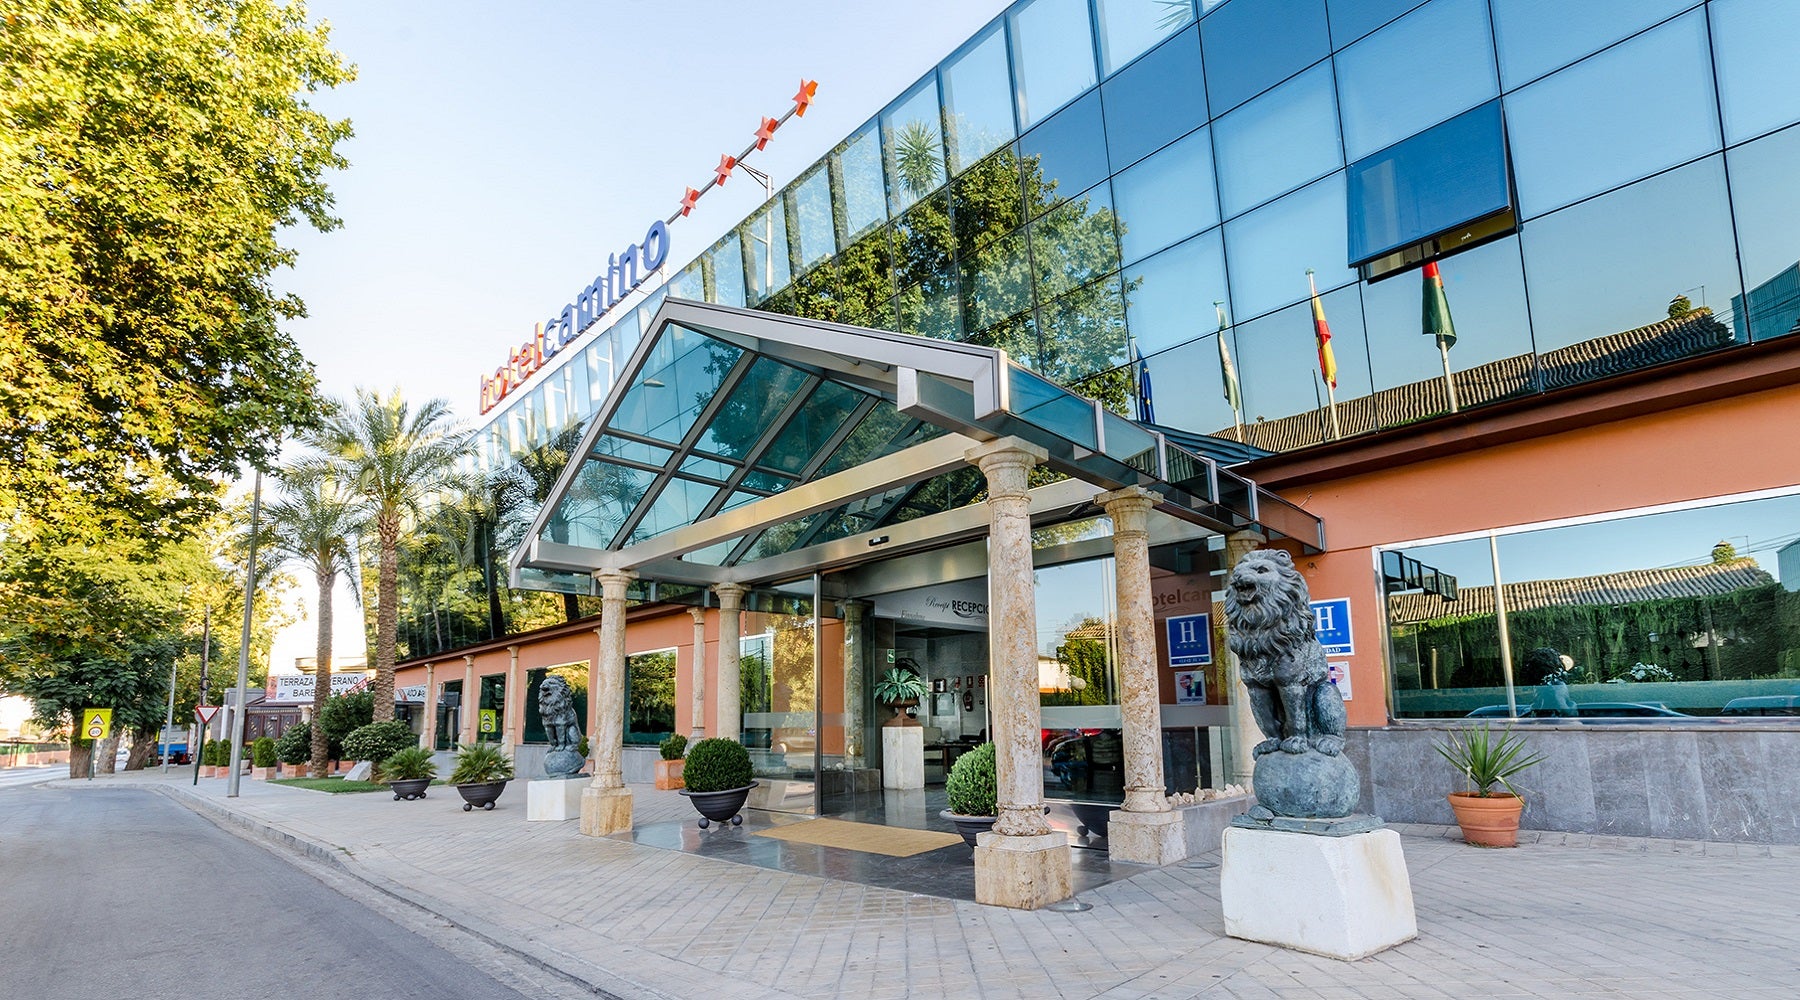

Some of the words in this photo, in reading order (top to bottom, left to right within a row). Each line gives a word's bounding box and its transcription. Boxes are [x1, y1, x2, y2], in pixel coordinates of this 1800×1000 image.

[1313, 606, 1336, 632] H
[1179, 620, 1198, 643] H
[280, 677, 314, 687] TERRAZA
[330, 676, 359, 686] ERANO
